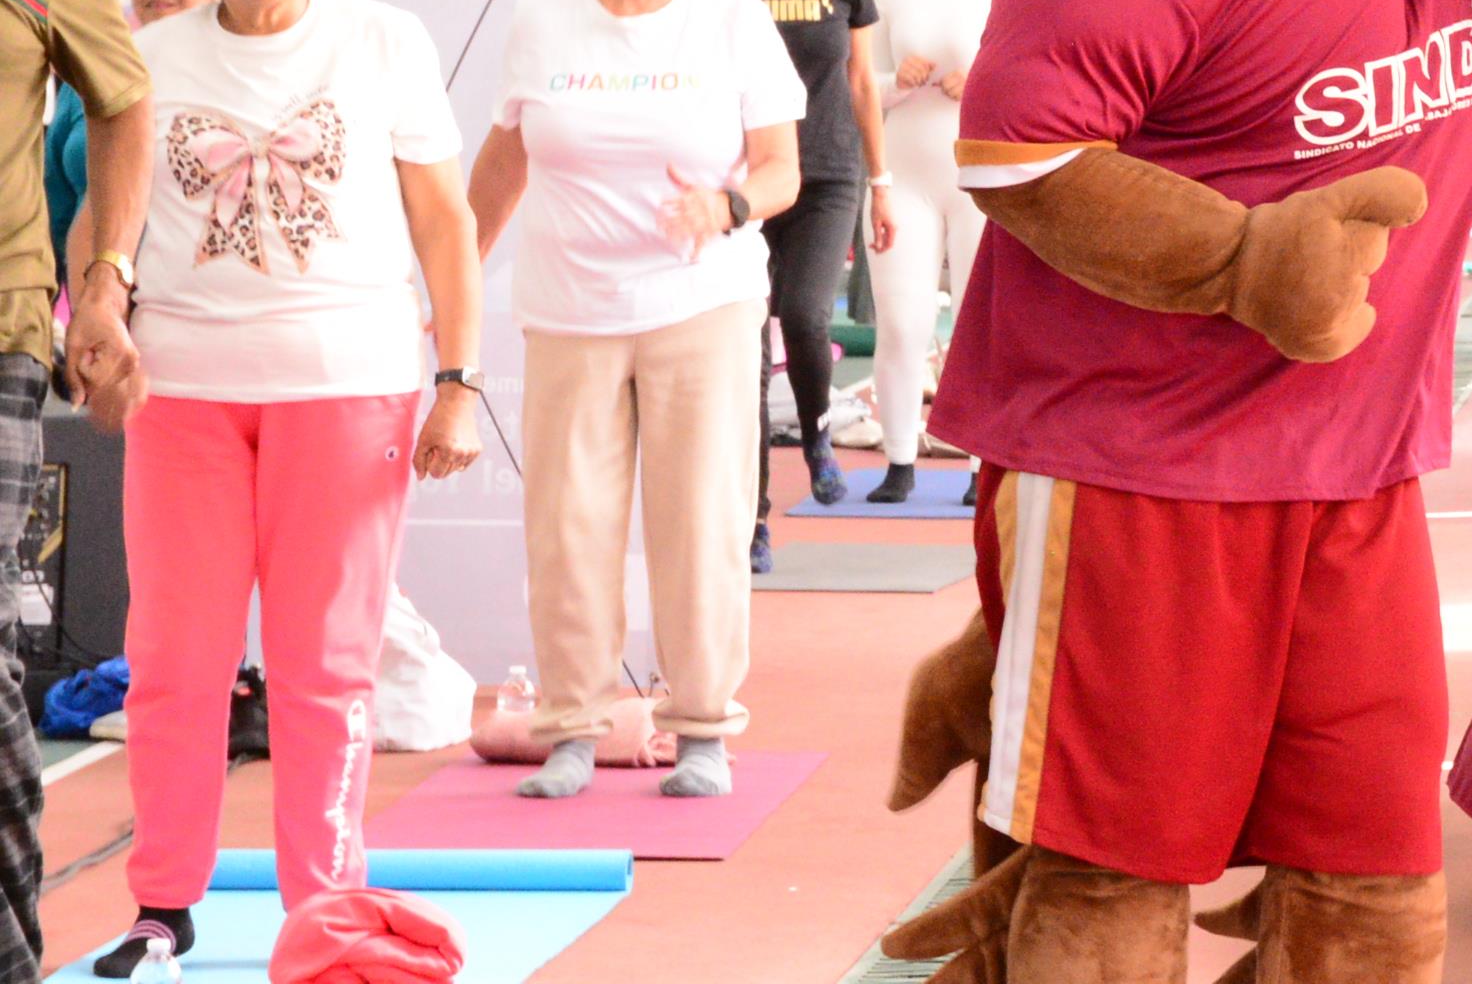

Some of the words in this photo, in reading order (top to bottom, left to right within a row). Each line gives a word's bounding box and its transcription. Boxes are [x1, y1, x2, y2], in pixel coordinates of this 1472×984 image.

[549, 71, 701, 92] CHAMPION
[1294, 141, 1354, 160] SINDICATO
[1405, 122, 1421, 134] DE
[324, 699, 366, 881] Champion
